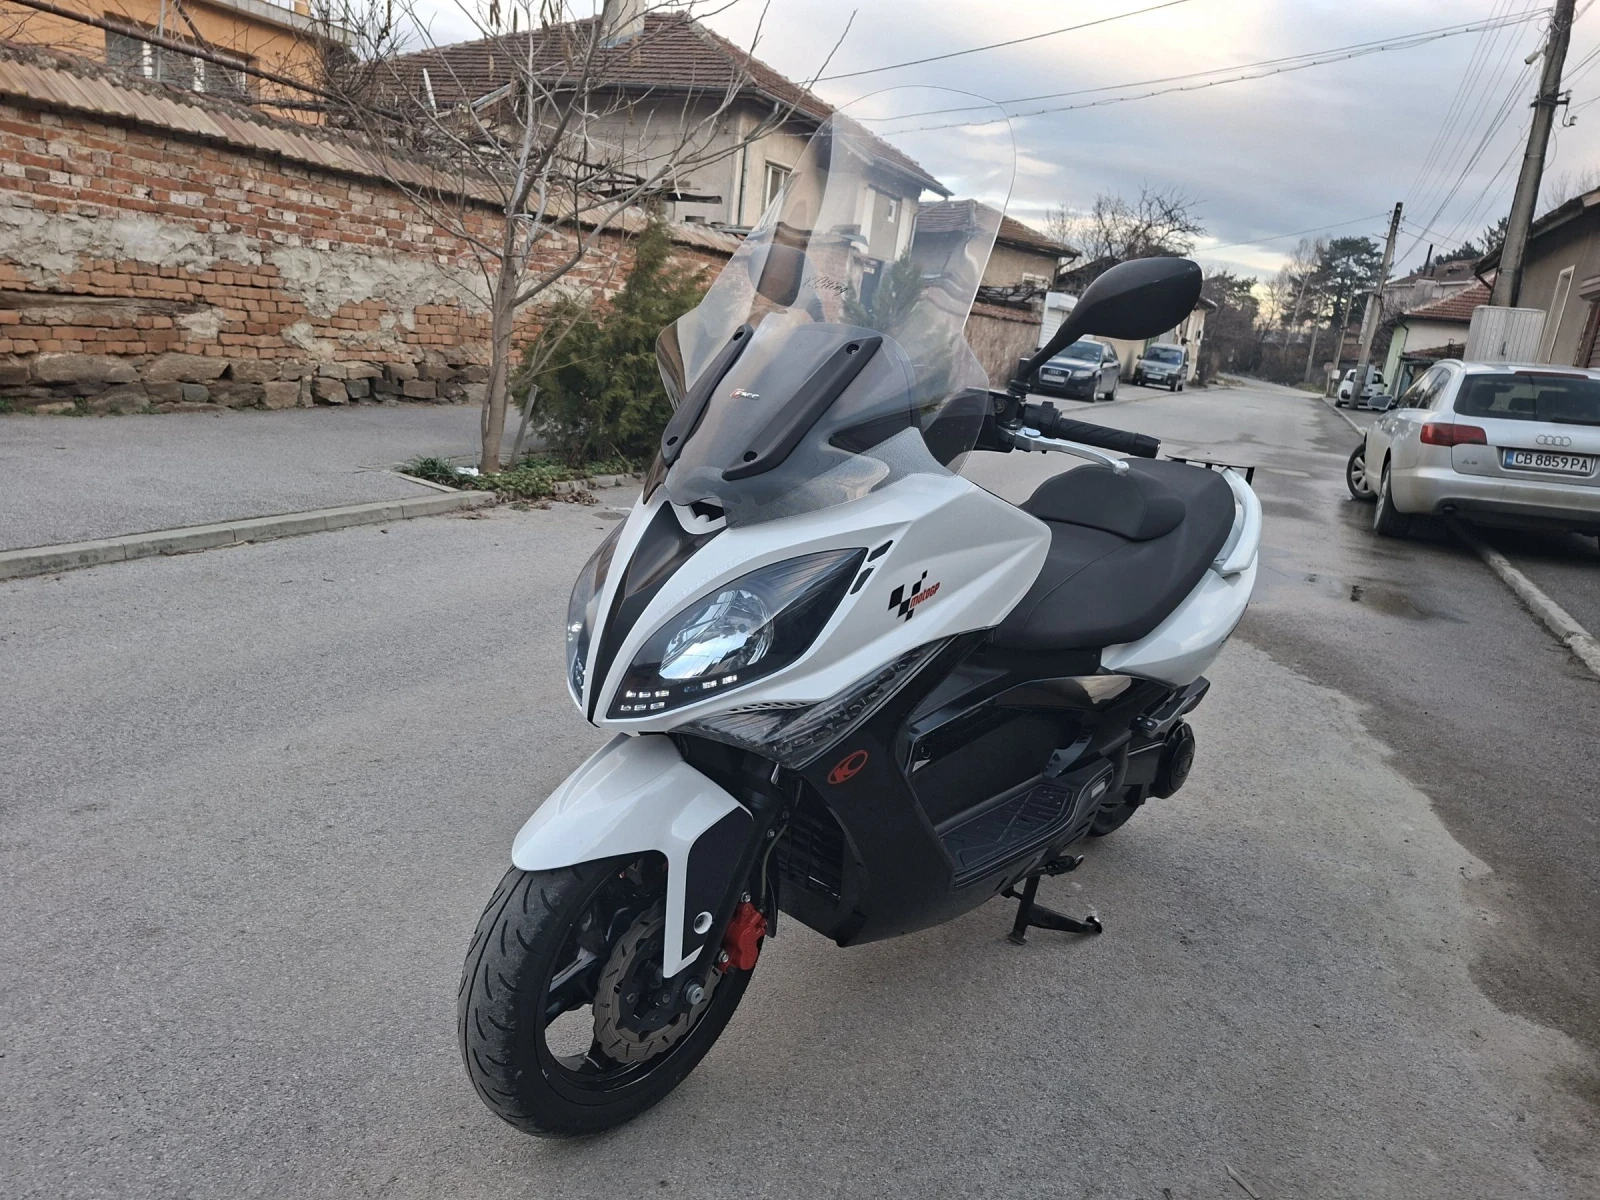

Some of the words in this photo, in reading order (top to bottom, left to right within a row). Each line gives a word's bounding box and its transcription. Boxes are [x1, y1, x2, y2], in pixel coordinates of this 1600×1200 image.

[1515, 452, 1533, 465] CB
[1535, 454, 1569, 469] 8859
[1570, 457, 1588, 471] PA
